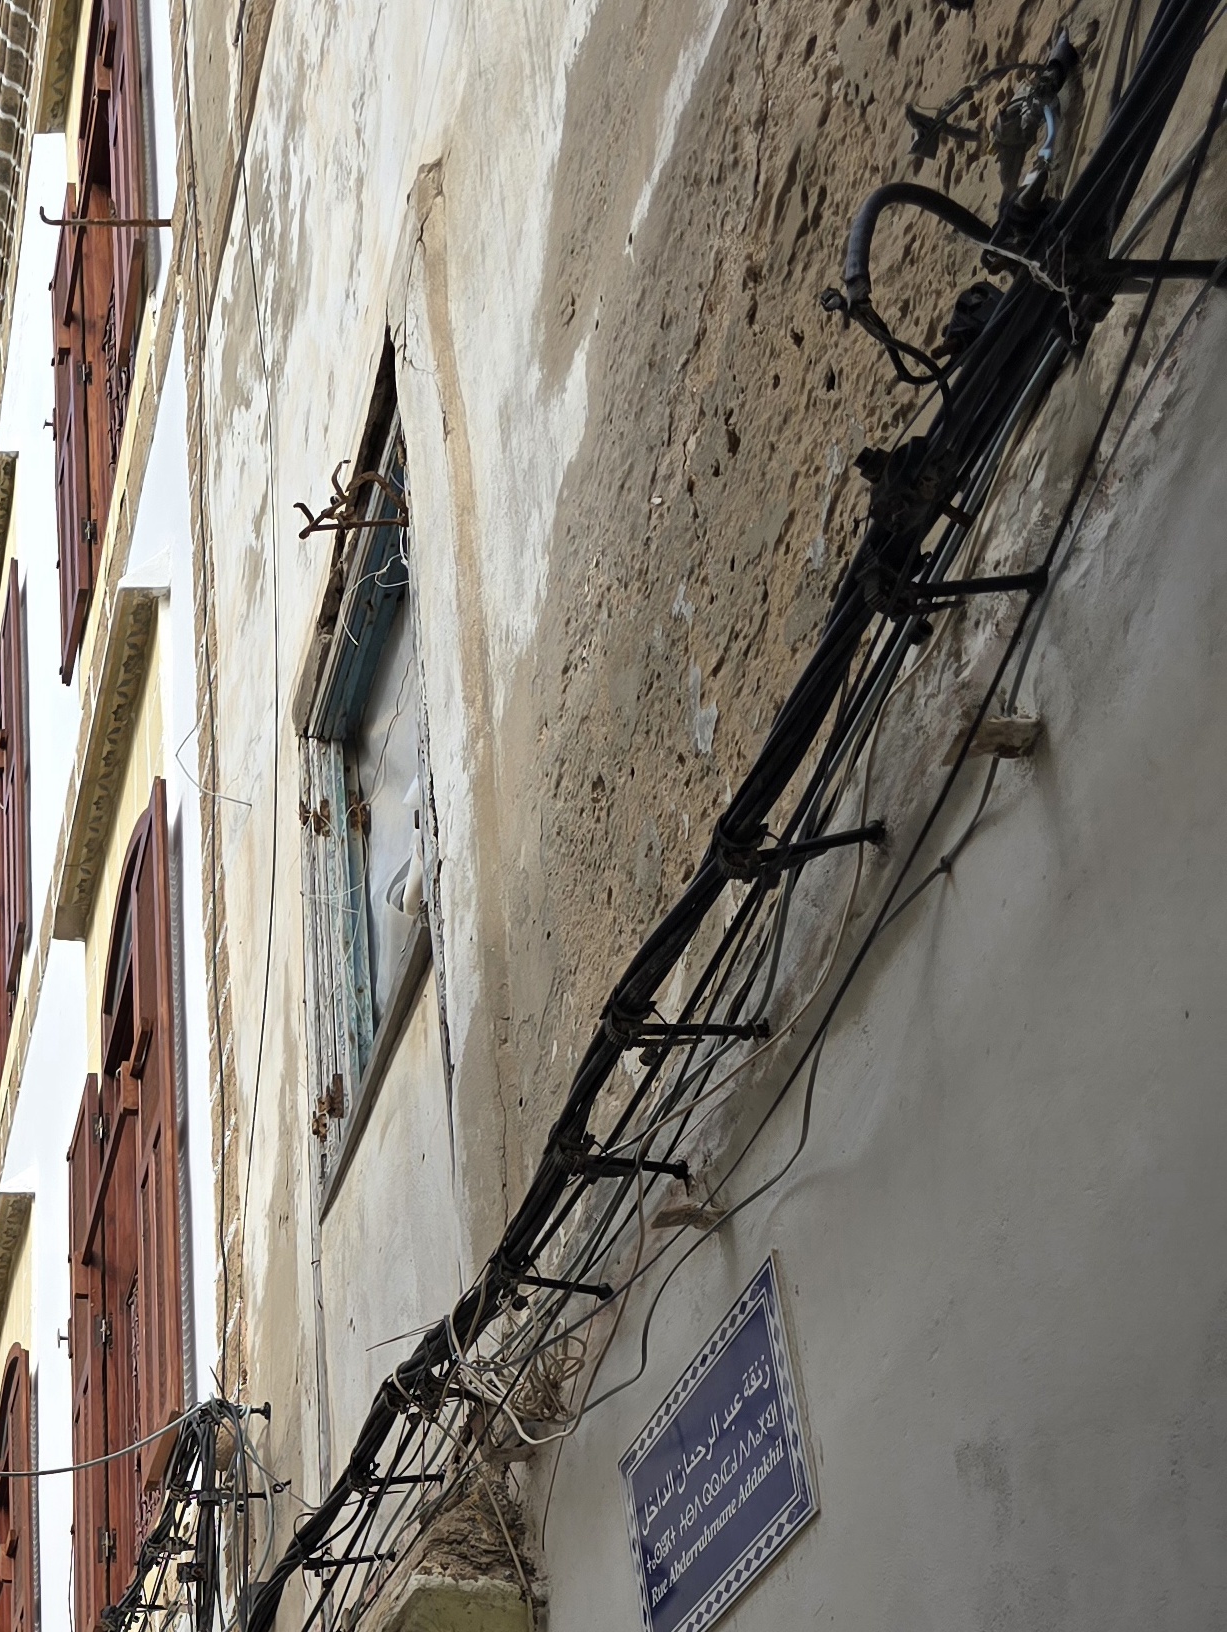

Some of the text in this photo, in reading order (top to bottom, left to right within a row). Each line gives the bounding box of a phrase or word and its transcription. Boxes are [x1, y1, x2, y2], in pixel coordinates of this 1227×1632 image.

[641, 1354, 770, 1536] زنقة عبد الرحمان الداخل
[651, 1436, 783, 1607] Rue Abderrahmane Addakhil
